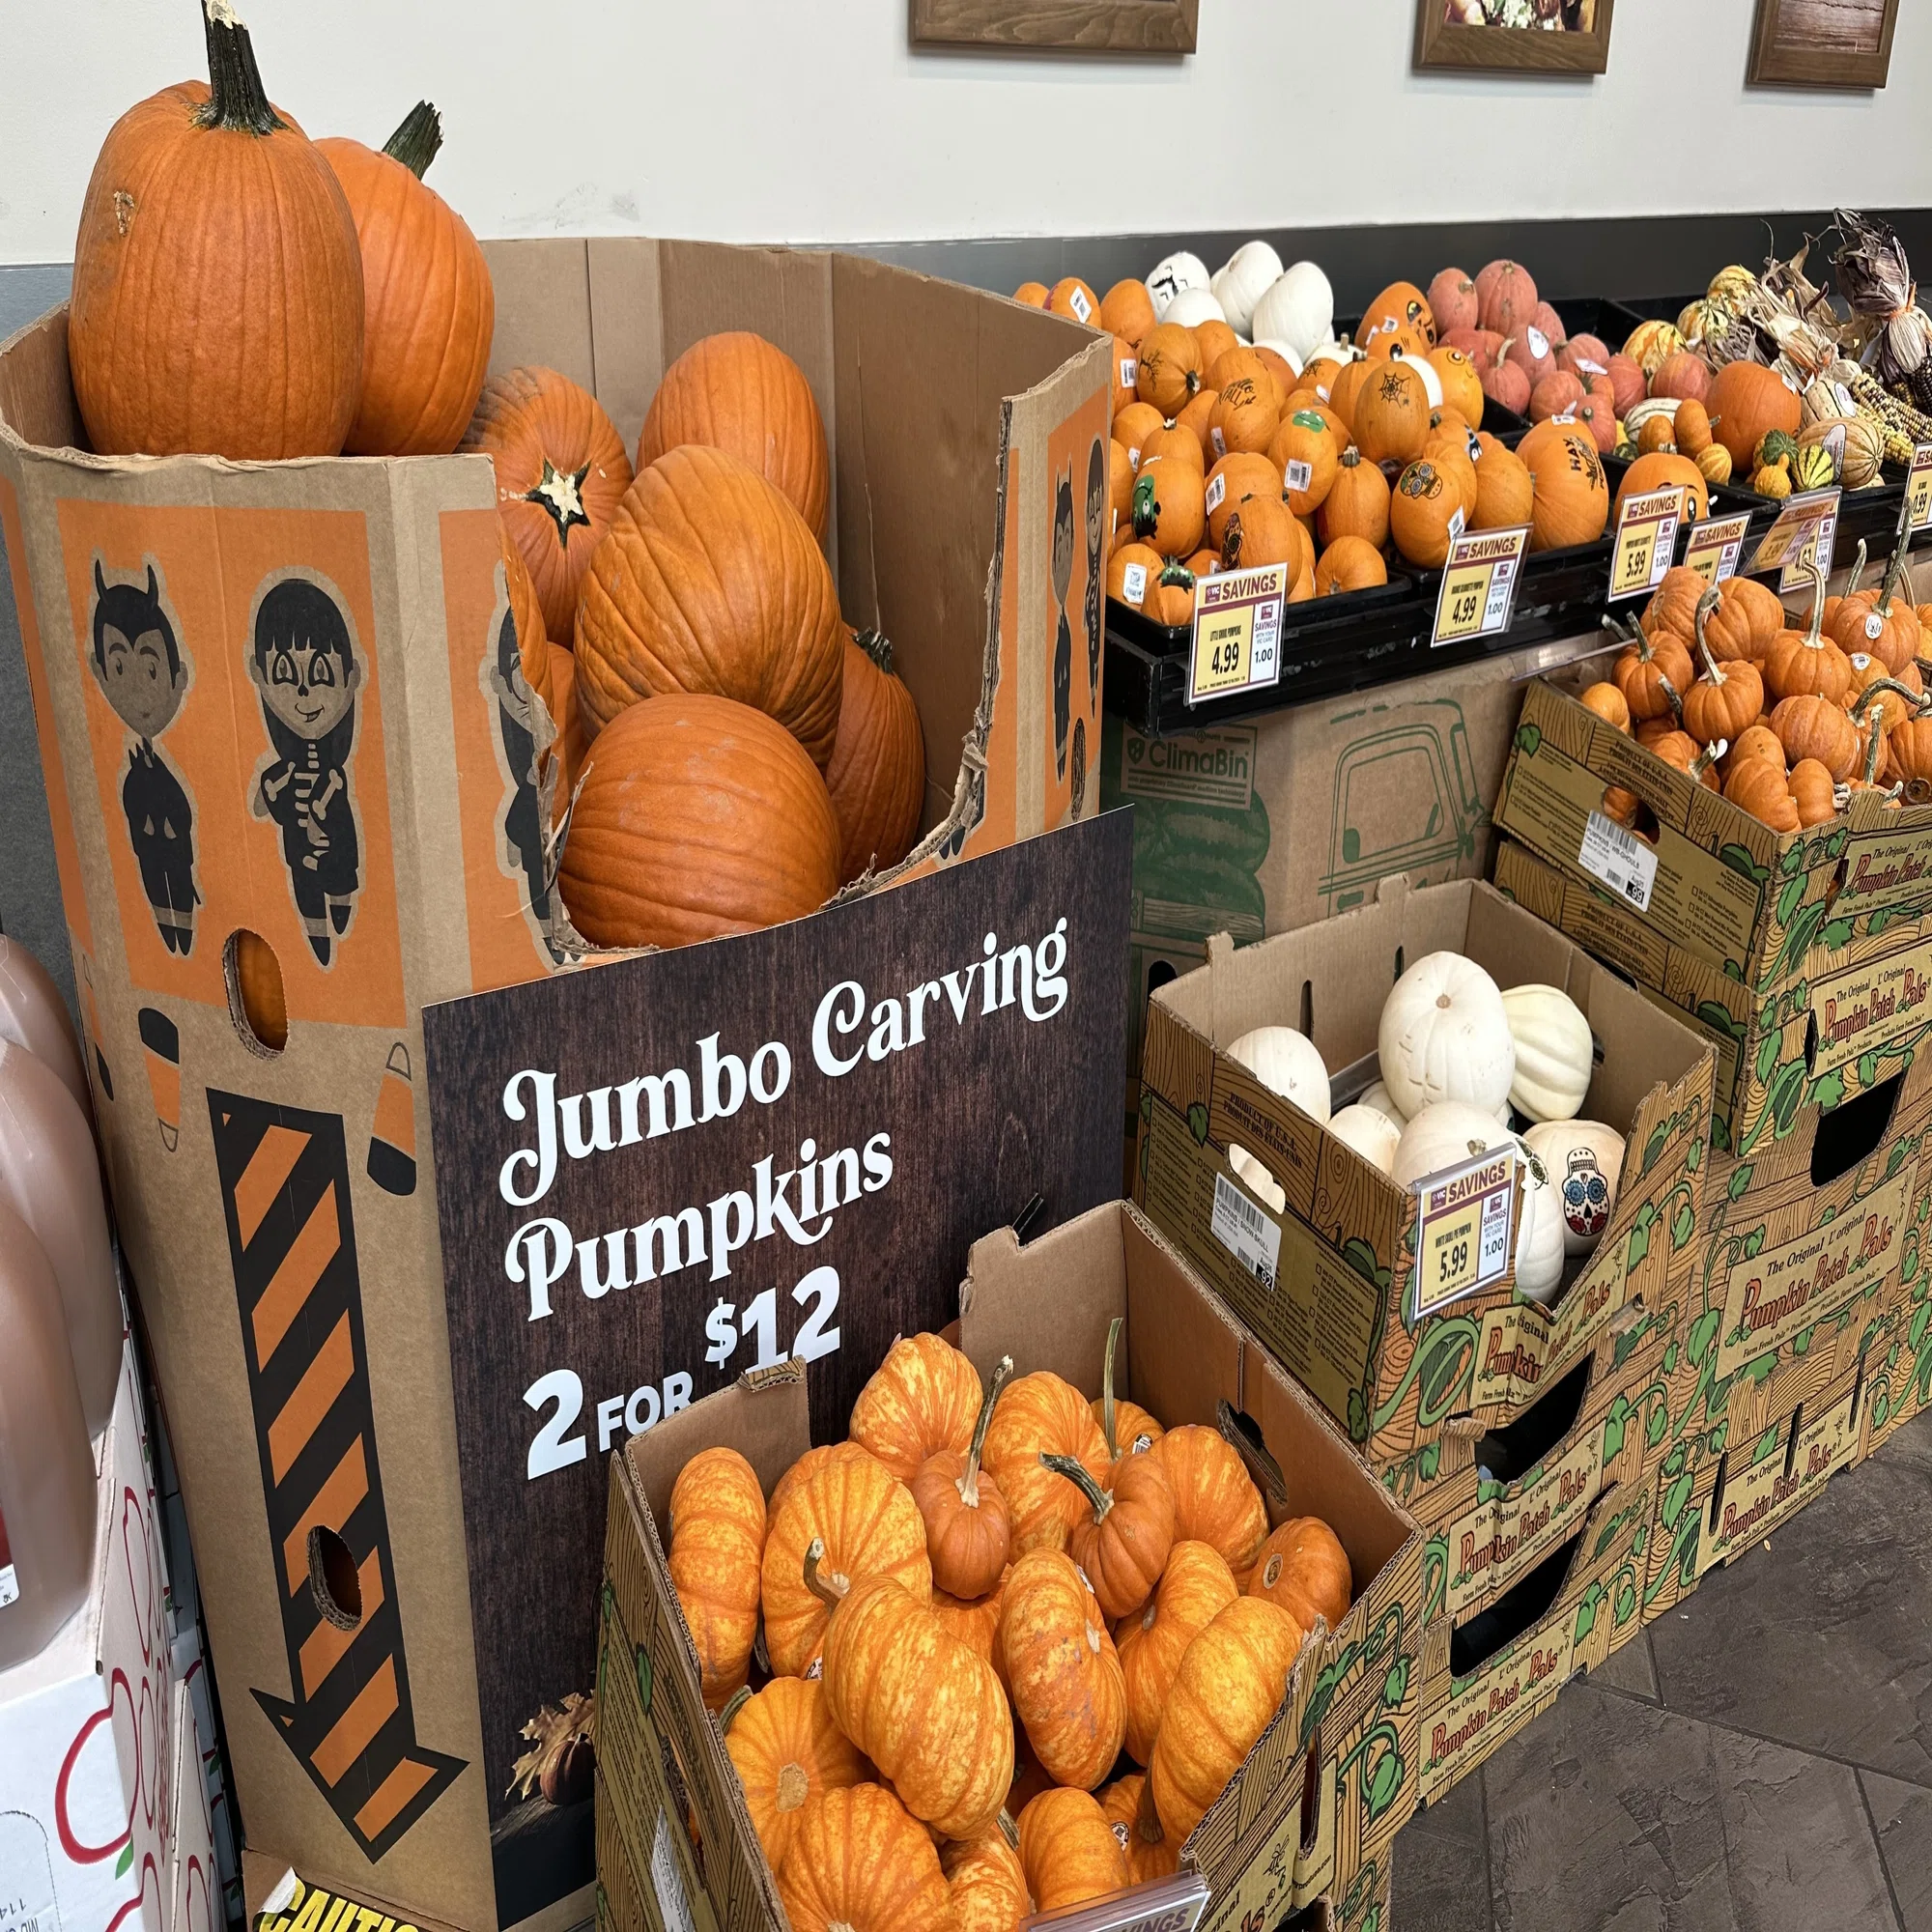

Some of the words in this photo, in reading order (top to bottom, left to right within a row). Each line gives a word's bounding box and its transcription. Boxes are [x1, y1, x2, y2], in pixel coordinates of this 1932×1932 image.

[1639, 496, 1677, 516] SAVINGS
[1469, 537, 1517, 558] SAVINGS
[1705, 523, 1742, 542] SAVINGS
[1627, 551, 1646, 578] 5.99
[1656, 555, 1668, 568] 1.00
[1222, 573, 1277, 601] SAVINGS
[1255, 619, 1277, 632] SAVINGS
[1452, 596, 1476, 624] 4.99
[1488, 602, 1503, 615] 1.00
[1211, 642, 1239, 674] 4.99
[1255, 648, 1273, 663] 1.00
[1150, 741, 1248, 779] ClimaBin
[1873, 849, 1884, 859] The
[1886, 843, 1911, 857] Original
[1851, 853, 1898, 896] Pumpkin
[1894, 853, 1928, 885] Patch
[1630, 885, 1643, 903] 99
[1837, 991, 1847, 1003] The
[1848, 979, 1870, 997] Original
[1884, 964, 1905, 981] Original
[1825, 999, 1868, 1043] Pumpkin
[1869, 987, 1895, 1025] Patch
[498, 1032, 791, 1207] Jumbo
[811, 918, 1069, 1077] Carving
[1229, 1091, 1263, 1123] PRODUCT
[1263, 1117, 1273, 1133] OF
[1436, 1189, 1446, 1200] VIC
[1448, 1161, 1506, 1203] SAVINGS
[504, 1131, 895, 1321] Pumpkins
[1216, 1196, 1237, 1223] PUMPKINS
[1483, 1208, 1507, 1227] SAVINGS
[1439, 1241, 1468, 1283] 5.99
[1485, 1237, 1504, 1258] 1.00
[1767, 1261, 1783, 1277] The
[1787, 1236, 1825, 1267] Original
[1260, 1267, 1271, 1291] 92
[1742, 1278, 1811, 1336] Pumpkin
[1809, 1246, 1849, 1299] Patch
[1505, 1316, 1516, 1328] The
[522, 1369, 587, 1481] 2
[597, 1371, 694, 1452] FOR
[704, 1265, 840, 1374] $12
[1747, 1473, 1757, 1487] The
[1759, 1453, 1783, 1477] Original
[1804, 1421, 1827, 1445] Original
[1475, 1515, 1487, 1528] The
[1489, 1505, 1520, 1524] Original
[1536, 1467, 1561, 1497] Original
[1722, 1502, 1771, 1540] Pumpkin
[1771, 1468, 1800, 1510] Patch
[1461, 1531, 1517, 1574] Pumpkin
[1518, 1500, 1549, 1548] Patch
[1447, 1704, 1460, 1719] The
[1463, 1680, 1490, 1707] Original
[1506, 1647, 1533, 1675] Original
[1432, 1721, 1486, 1763] Pumpkin
[1487, 1677, 1520, 1722] Patch
